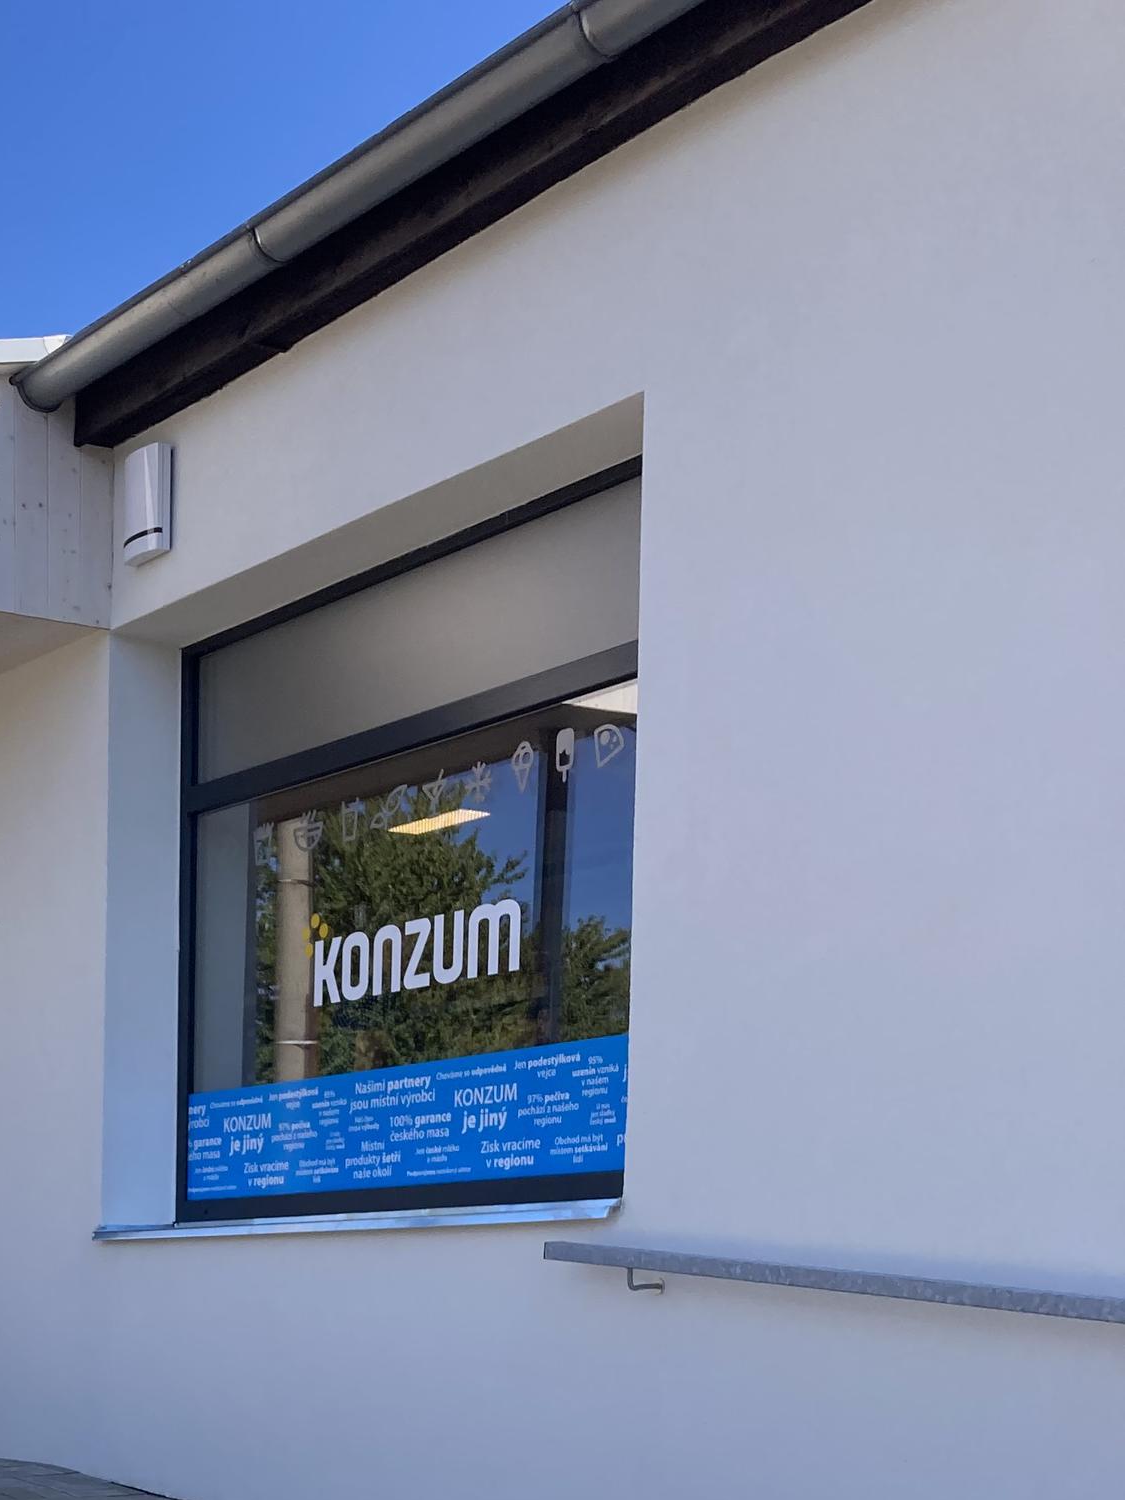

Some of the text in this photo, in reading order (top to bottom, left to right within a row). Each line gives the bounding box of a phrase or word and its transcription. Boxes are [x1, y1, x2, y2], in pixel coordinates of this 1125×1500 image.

[355, 1079, 385, 1095] Našimi
[387, 1076, 431, 1094] partnery
[349, 1100, 369, 1114] jsou
[370, 1094, 399, 1108] místní
[401, 1089, 435, 1107] výrobci
[454, 1083, 517, 1108] KONZUM
[223, 1113, 272, 1133] KONZUM
[390, 1115, 413, 1127] 100%
[415, 1112, 452, 1128] garance
[461, 1106, 507, 1135] je jiný
[390, 1127, 449, 1142] českého masa
[193, 1137, 222, 1152] garance
[229, 1133, 264, 1156] je jiný
[481, 1138, 541, 1154] Zisk vracíme
[243, 1162, 259, 1174] Zisk
[345, 1151, 401, 1169] produkty šetří
[493, 1153, 535, 1170] regionu
[353, 1168, 371, 1179] naše
[372, 1165, 392, 1178] okolí
[253, 1174, 284, 1189] regionu
